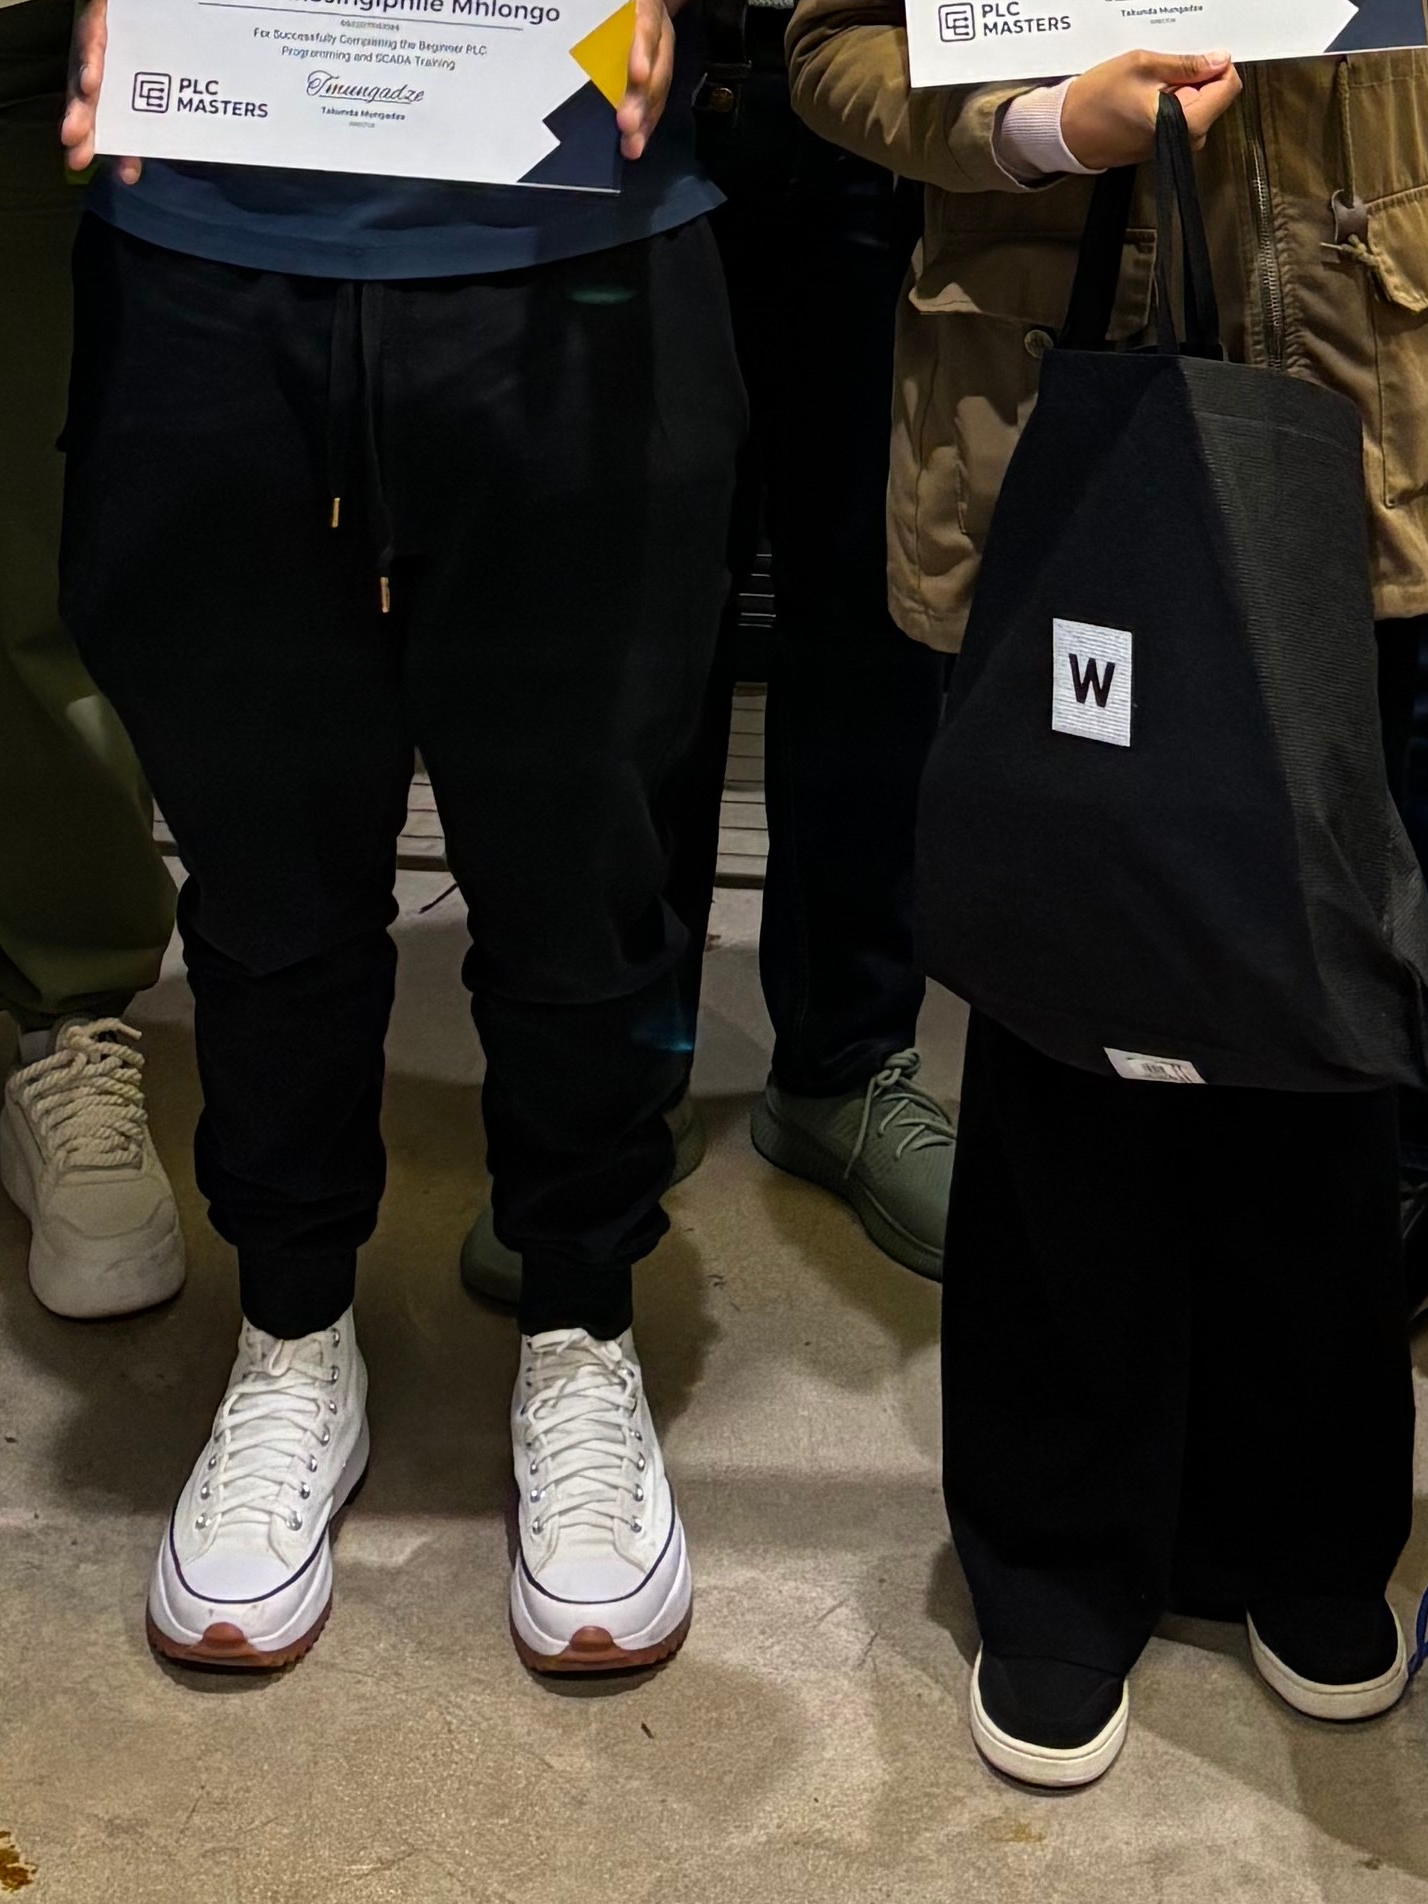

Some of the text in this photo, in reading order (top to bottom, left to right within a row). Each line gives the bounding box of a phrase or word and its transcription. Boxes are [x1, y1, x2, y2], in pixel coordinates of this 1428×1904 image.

[982, 1, 1020, 18] PLC
[984, 16, 1071, 36] MASTERS
[179, 78, 219, 95] PLC
[177, 97, 268, 118] MASTERS
[1069, 653, 1116, 708] W
